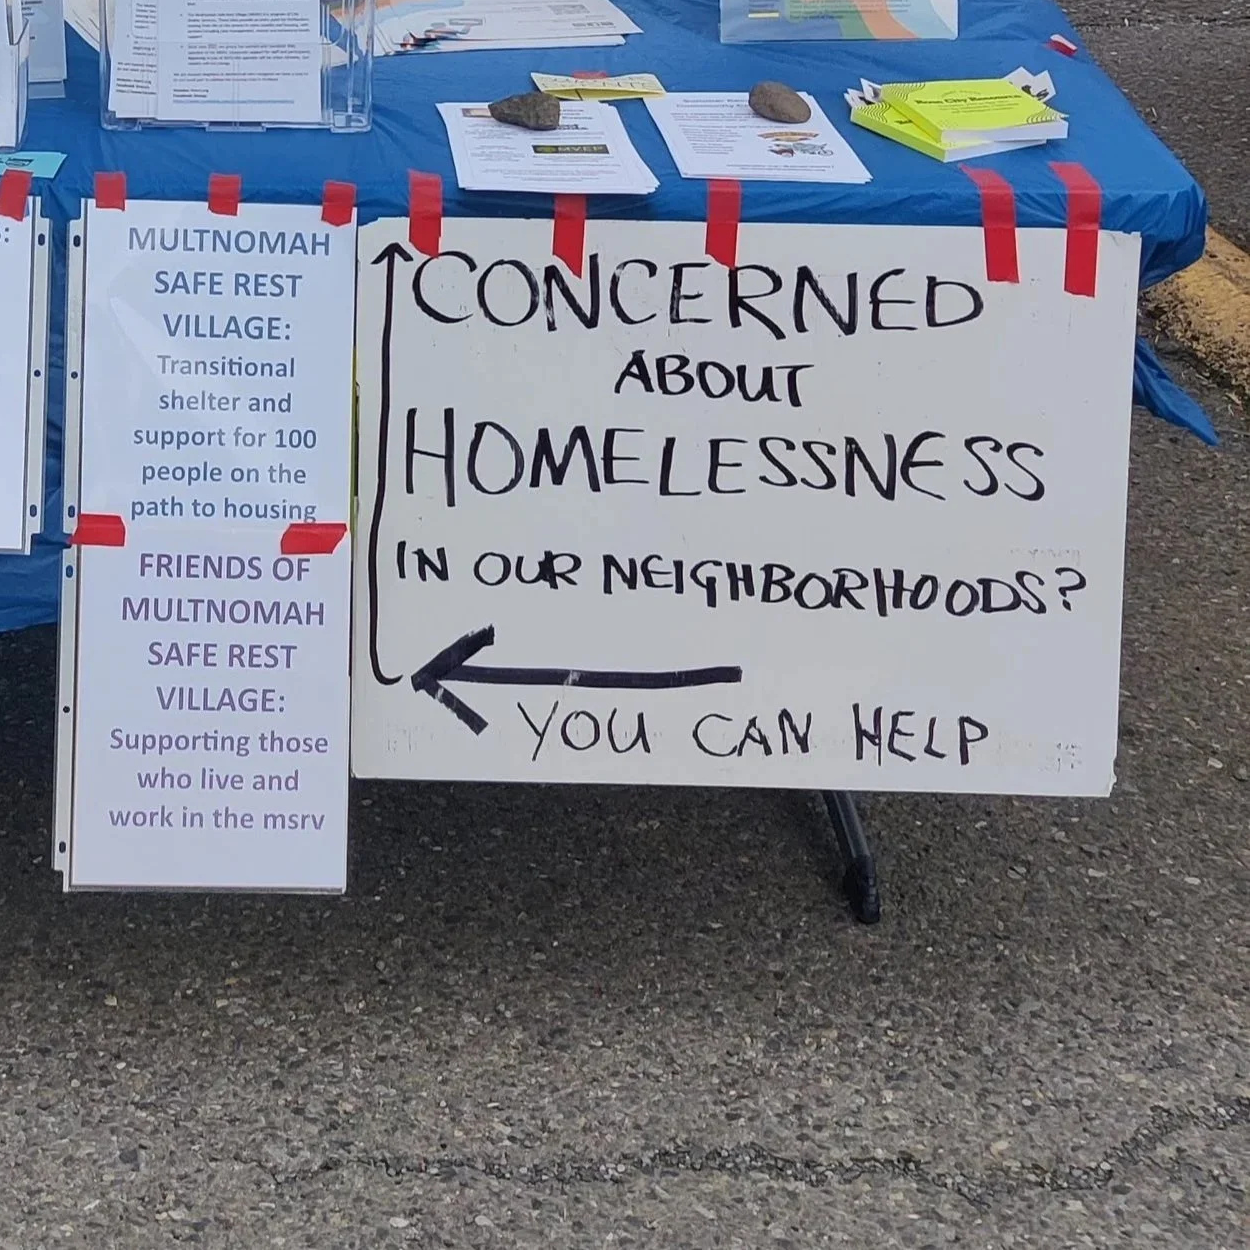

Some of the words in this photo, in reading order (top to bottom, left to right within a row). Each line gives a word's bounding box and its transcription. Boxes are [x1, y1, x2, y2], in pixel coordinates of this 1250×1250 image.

[129, 227, 330, 256] MULTNOMAH
[154, 270, 223, 295] SAFE
[234, 273, 303, 298] REST
[410, 250, 984, 341] CONCERNED
[163, 314, 291, 340] VILLAGE:
[158, 355, 295, 378] Transitional
[614, 350, 816, 408] ABOUT
[159, 390, 241, 411] shelter
[248, 393, 291, 413] and
[133, 427, 225, 451] support
[234, 427, 267, 447] for
[275, 429, 317, 449] 100
[404, 407, 1047, 509] HOMELESSNESS
[142, 462, 222, 486] people
[231, 466, 259, 484] on
[268, 464, 306, 484] the
[131, 497, 184, 521] path
[192, 500, 215, 518] to
[224, 497, 317, 523] housing
[140, 553, 262, 581] FRIENDS
[273, 557, 310, 581] OF
[396, 540, 450, 582] IN
[473, 552, 583, 589] OUR
[603, 560, 1088, 618] NEIGHBORHOODS?
[122, 597, 325, 626] MULTNOMAH
[148, 642, 218, 667] SAFE
[228, 645, 297, 669] REST
[156, 686, 285, 712] VILLAGE:
[110, 728, 250, 756] Supporting
[259, 730, 329, 753] those
[516, 701, 652, 762] YOU
[693, 710, 814, 759] CAN
[854, 701, 991, 766] HELP
[138, 767, 192, 790] who
[201, 768, 244, 790] live
[253, 769, 299, 791] and
[109, 806, 173, 828] work
[182, 806, 203, 828] in
[213, 807, 254, 829] the
[263, 812, 326, 831] msrv
